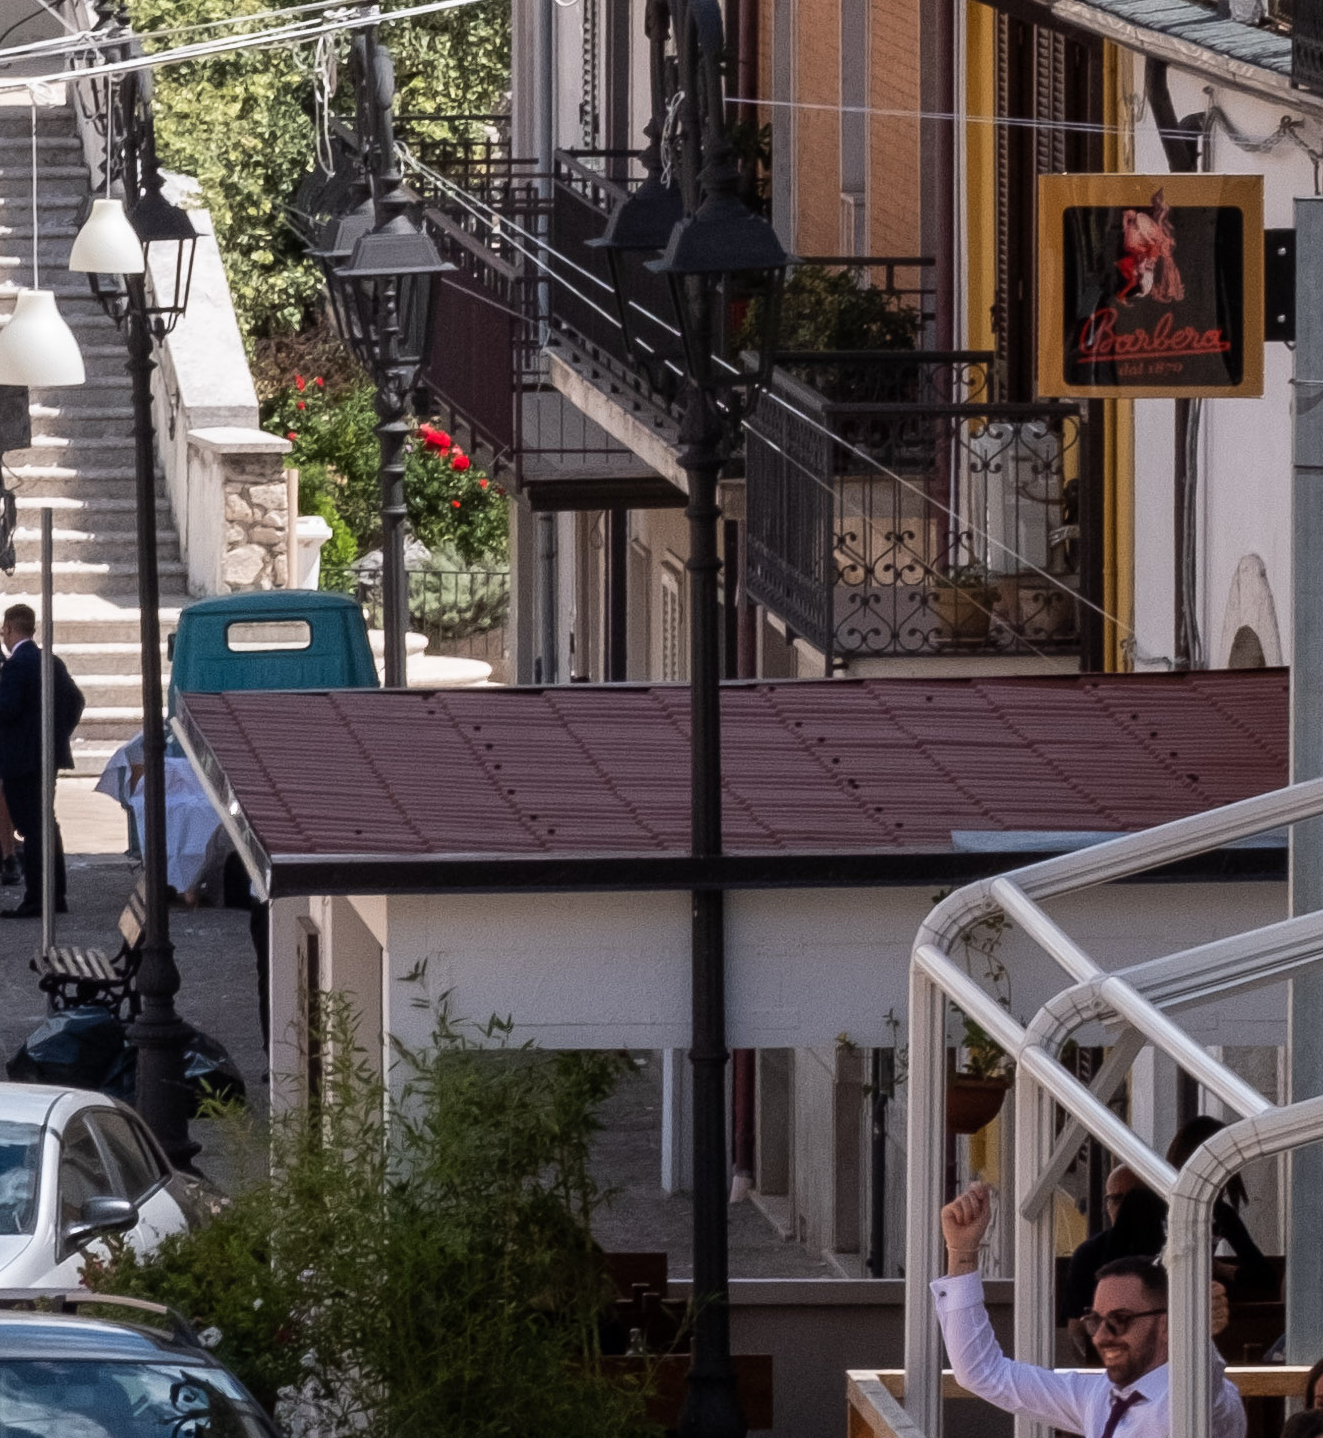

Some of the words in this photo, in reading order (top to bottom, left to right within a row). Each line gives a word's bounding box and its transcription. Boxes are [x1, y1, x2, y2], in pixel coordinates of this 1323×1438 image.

[1079, 306, 1227, 354] Barbera
[1118, 362, 1143, 375] dal
[1148, 362, 1183, 375] 1870
